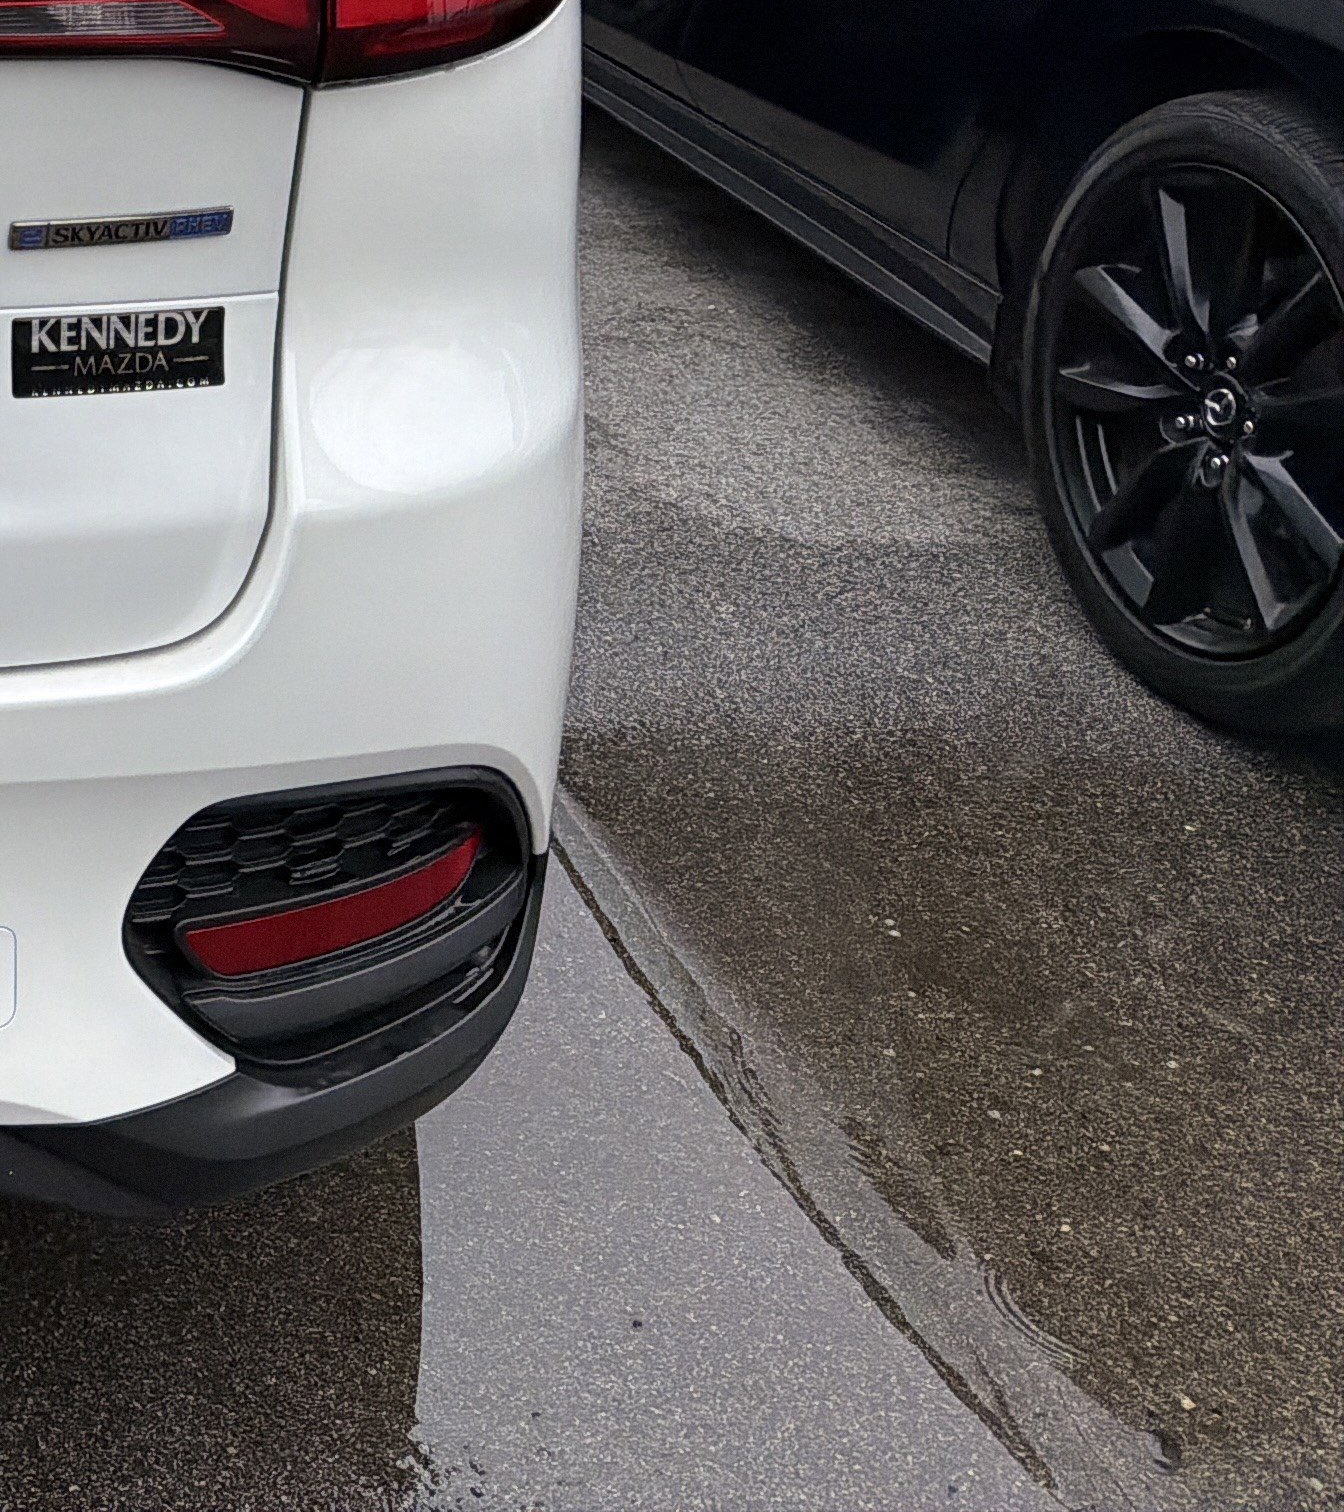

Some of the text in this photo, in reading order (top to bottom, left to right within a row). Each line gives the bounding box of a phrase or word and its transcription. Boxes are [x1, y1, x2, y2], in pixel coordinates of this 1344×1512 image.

[52, 219, 169, 245] SKYACTIV
[30, 309, 209, 354] KENNEDY
[73, 350, 169, 377] MAZDA
